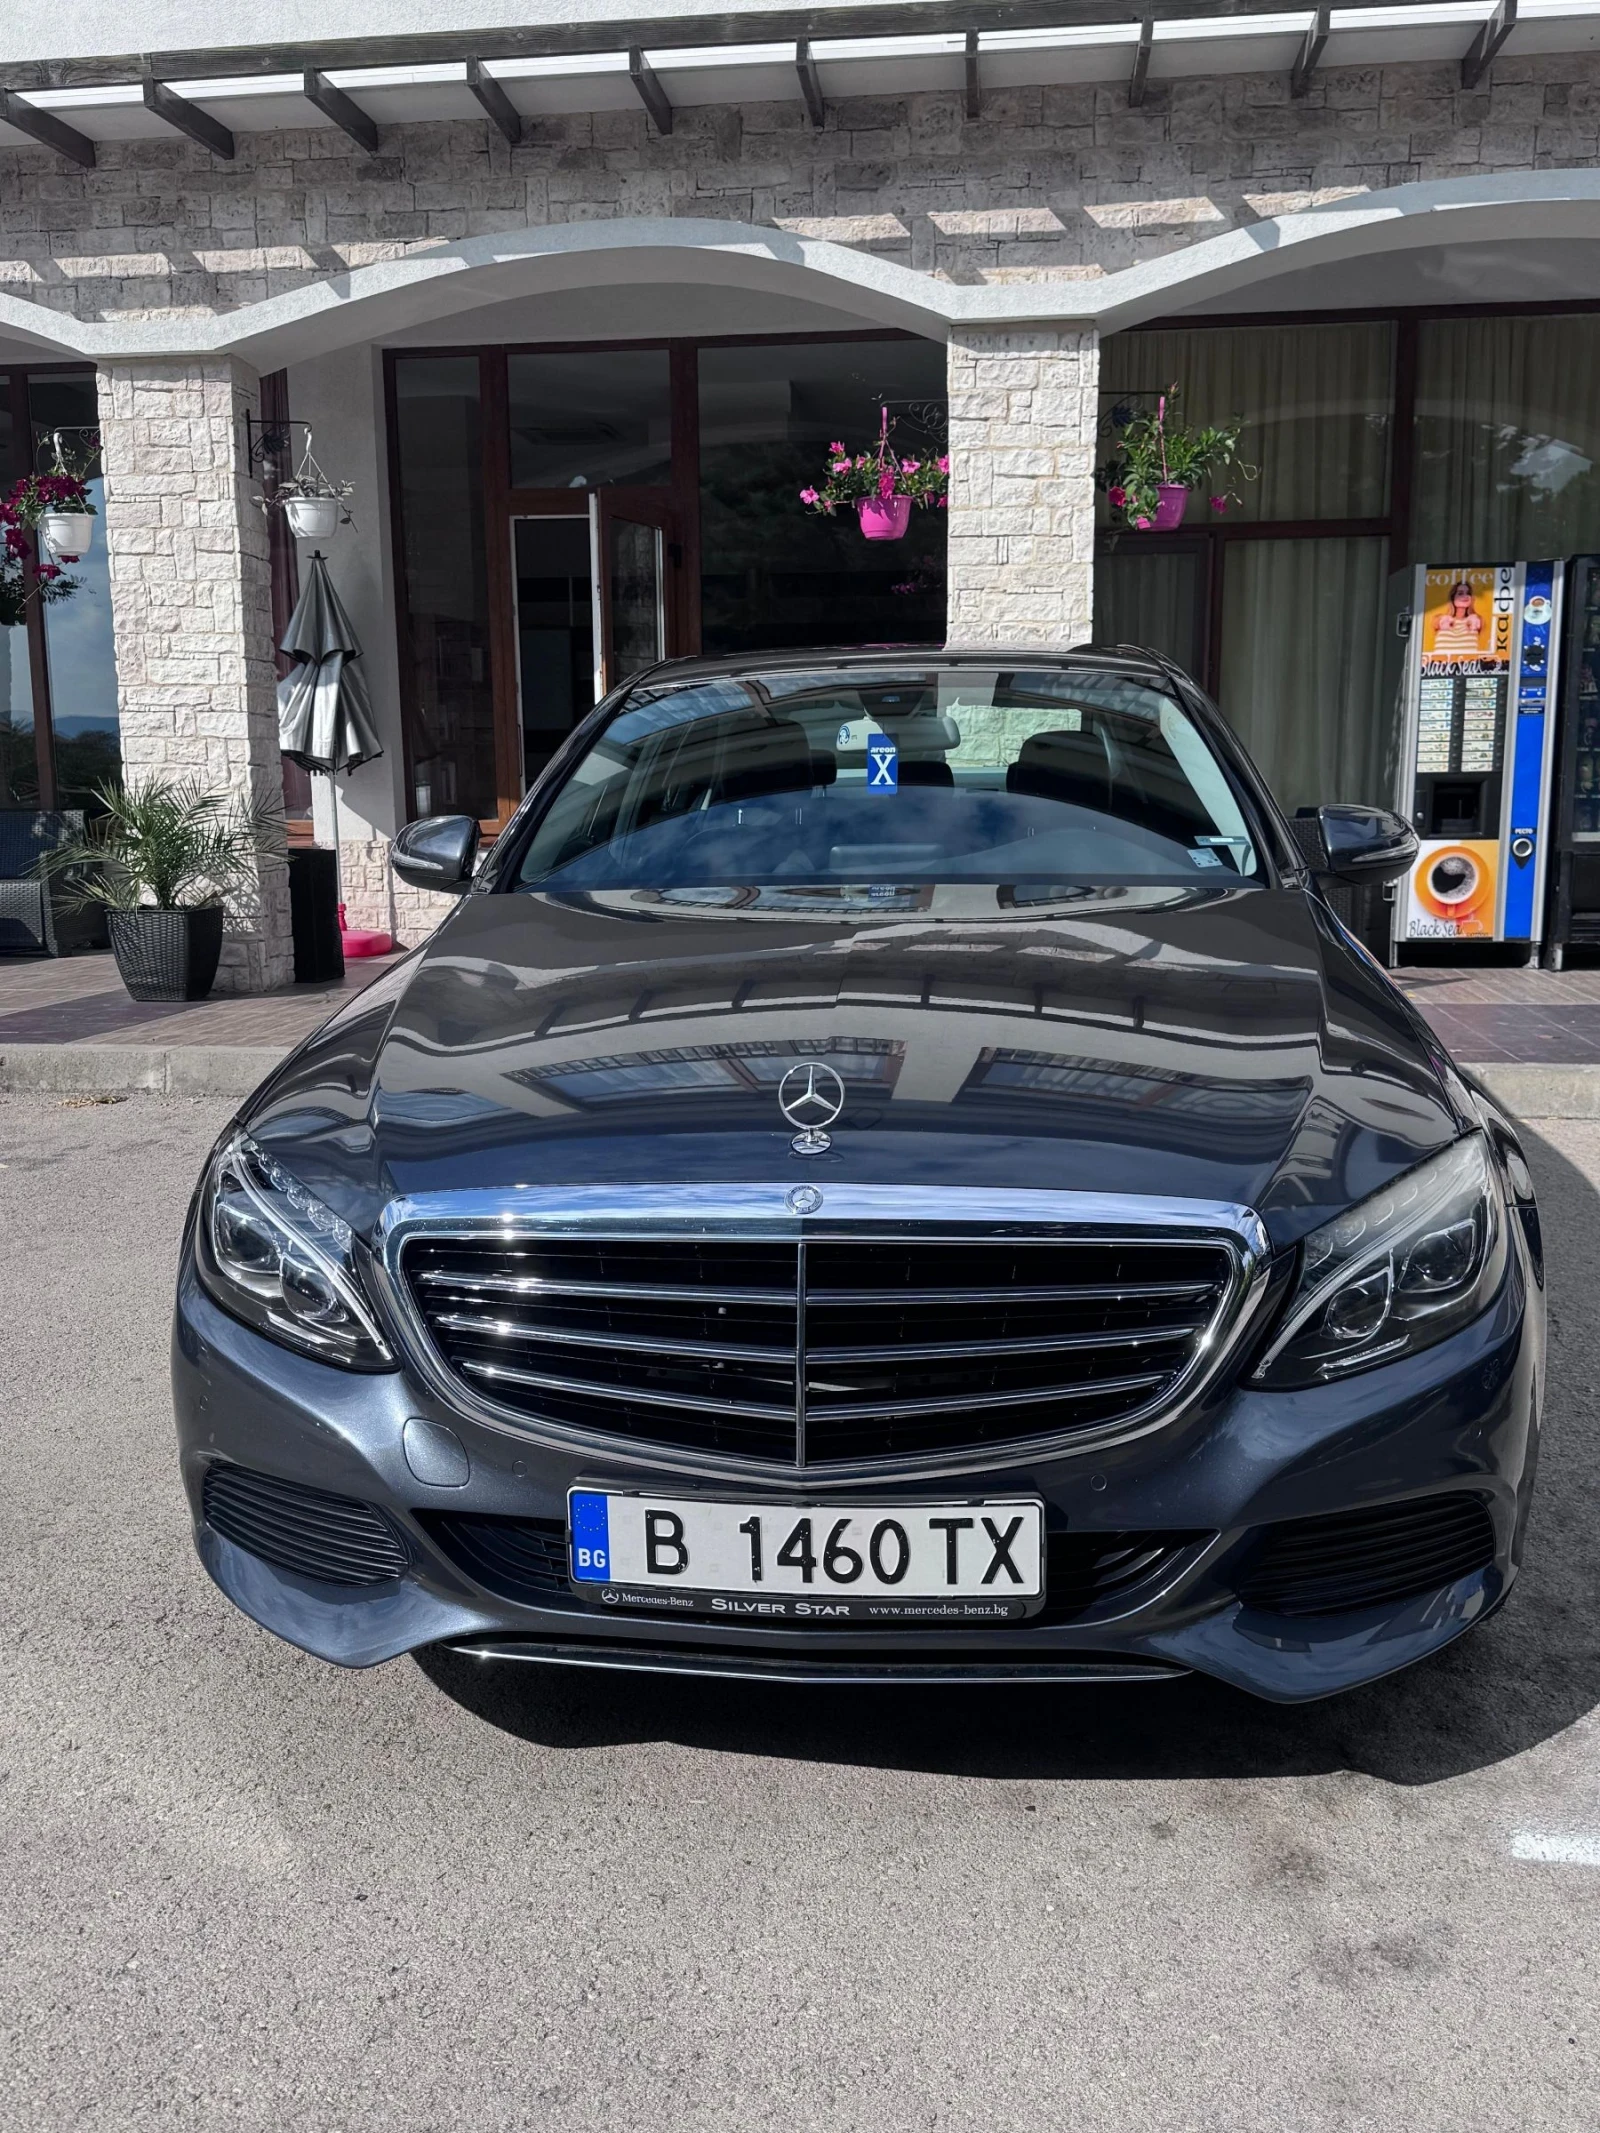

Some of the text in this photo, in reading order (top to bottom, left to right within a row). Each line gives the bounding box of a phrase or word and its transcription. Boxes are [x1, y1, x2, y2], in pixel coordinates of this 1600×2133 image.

[1426, 568, 1493, 586] coffee
[1494, 568, 1514, 651] кафе
[1421, 654, 1479, 677] Black Sea
[870, 754, 896, 786] X
[1409, 919, 1463, 938] Black Sea
[578, 1548, 606, 1568] BG
[645, 1509, 1024, 1585] B 1460 TX
[622, 1592, 1008, 1616] Mercedes-Benz SILVER STAR www.mercedes-benz.bg
